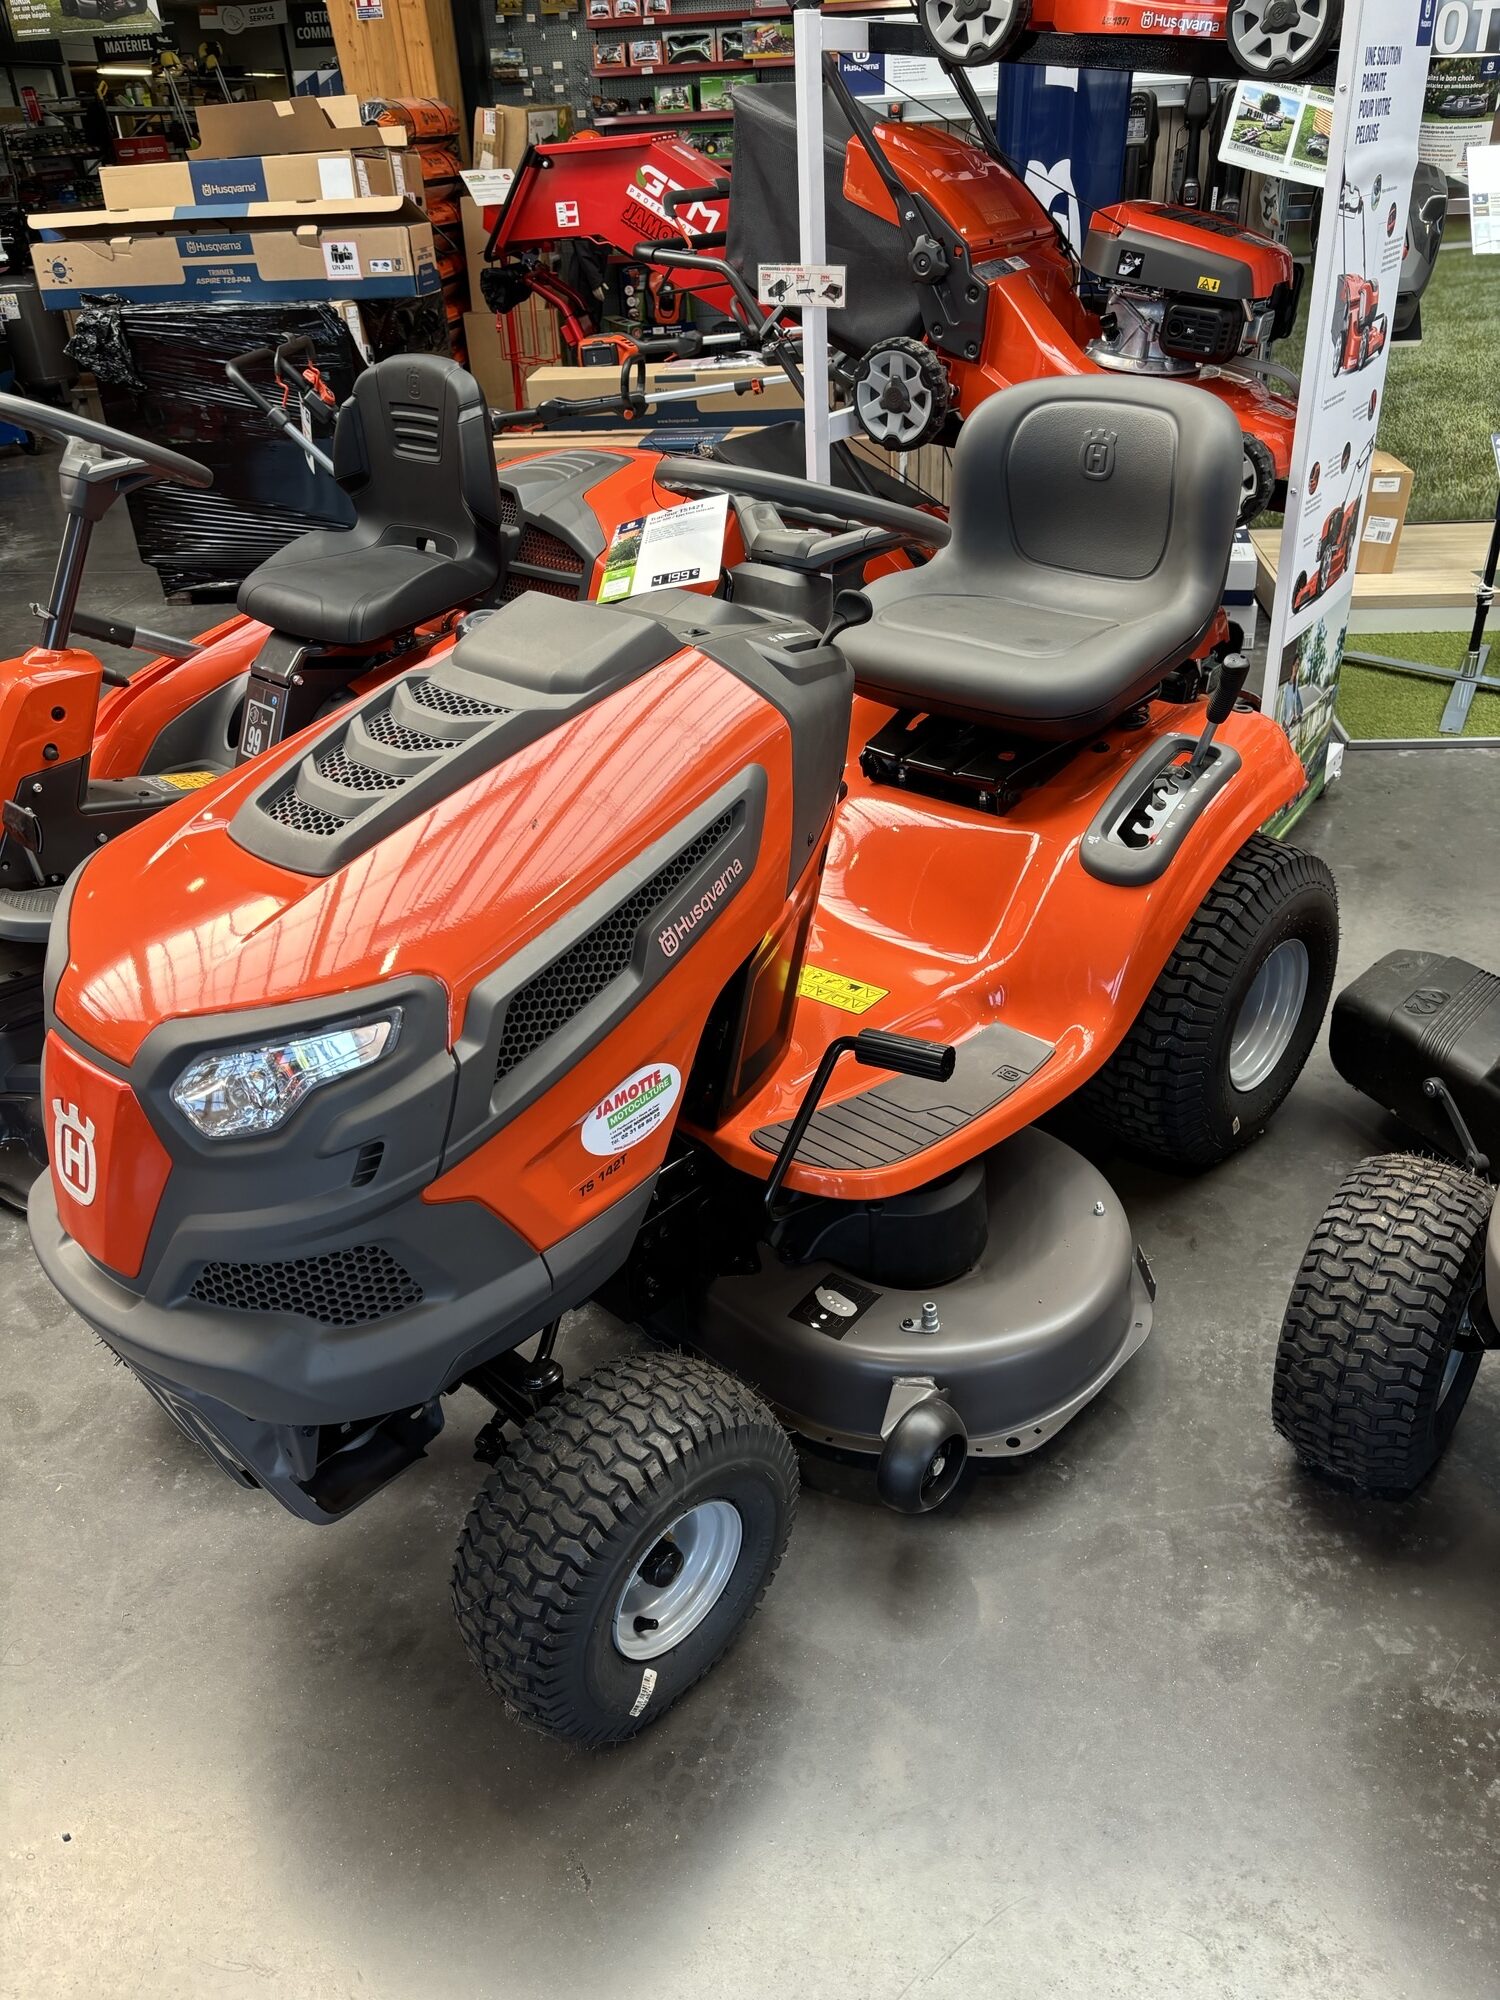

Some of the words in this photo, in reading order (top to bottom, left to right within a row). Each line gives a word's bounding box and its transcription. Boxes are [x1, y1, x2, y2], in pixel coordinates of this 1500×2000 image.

[250, 13, 275, 22] SERVICE
[1154, 13, 1220, 32] Husqvarna
[104, 38, 153, 54] MATÉRIEL
[1365, 47, 1377, 66] UNE
[1377, 46, 1402, 66] SOLUTION
[1361, 72, 1387, 92] PARFAITE
[1358, 99, 1375, 119] POUR
[1374, 97, 1391, 116] VOTRE
[1355, 123, 1380, 144] PELOUSE
[211, 183, 257, 195] Husqvarna
[196, 240, 242, 252] Husqvarna
[196, 277, 221, 285] ASPIRE
[667, 571, 690, 583] 199
[673, 858, 744, 941] Husqvarna
[595, 1069, 662, 1120] JAMOTTE
[609, 1076, 671, 1126] MOTOCULTURE
[579, 1180, 594, 1197] TS
[598, 1153, 628, 1182] 142T
